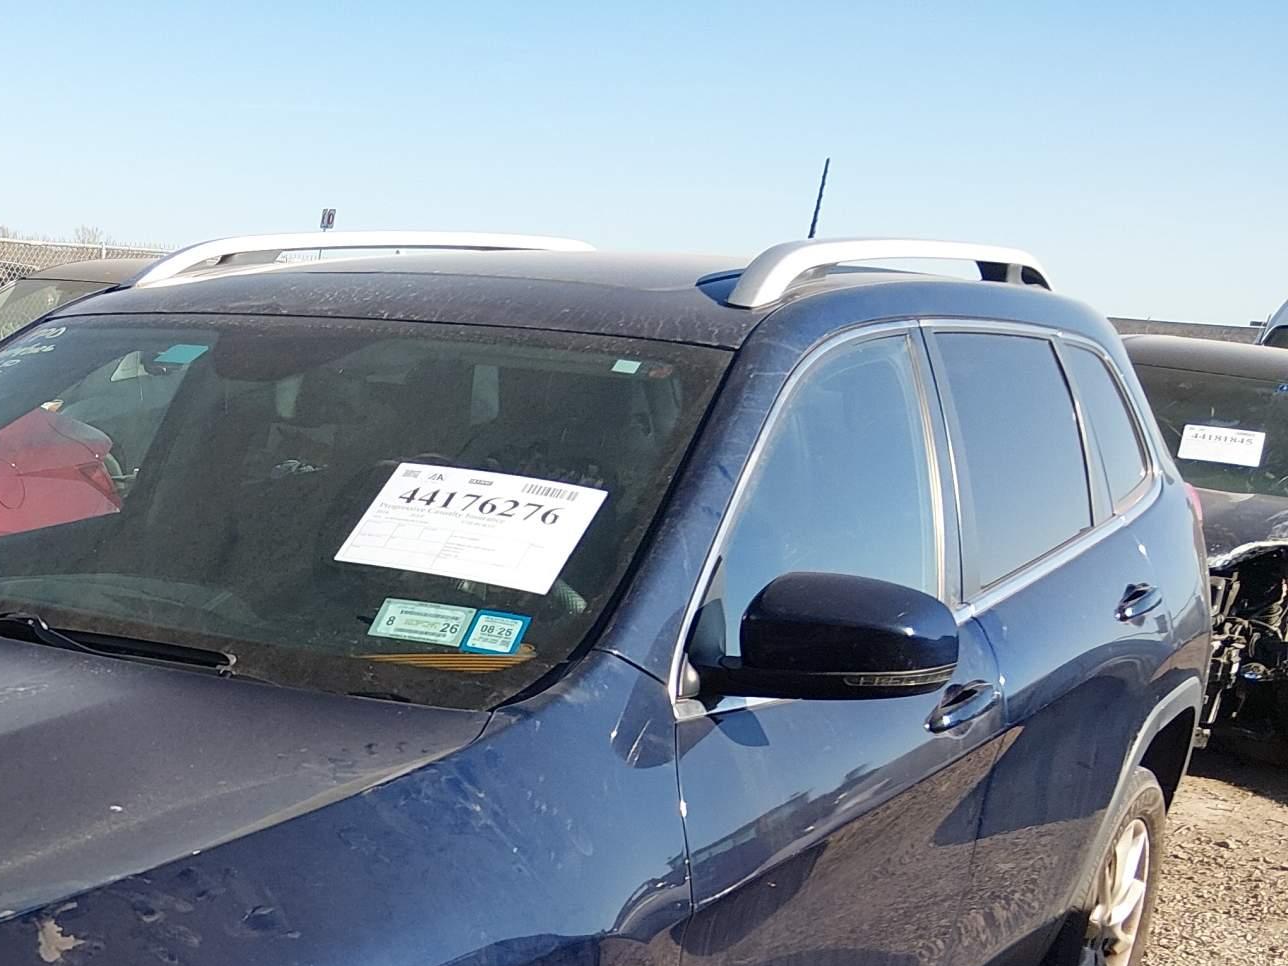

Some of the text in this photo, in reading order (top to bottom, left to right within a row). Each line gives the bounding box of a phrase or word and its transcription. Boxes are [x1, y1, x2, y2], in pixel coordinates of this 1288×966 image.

[398, 486, 566, 525] 44176276
[385, 615, 396, 627] 8
[439, 621, 460, 635] 26
